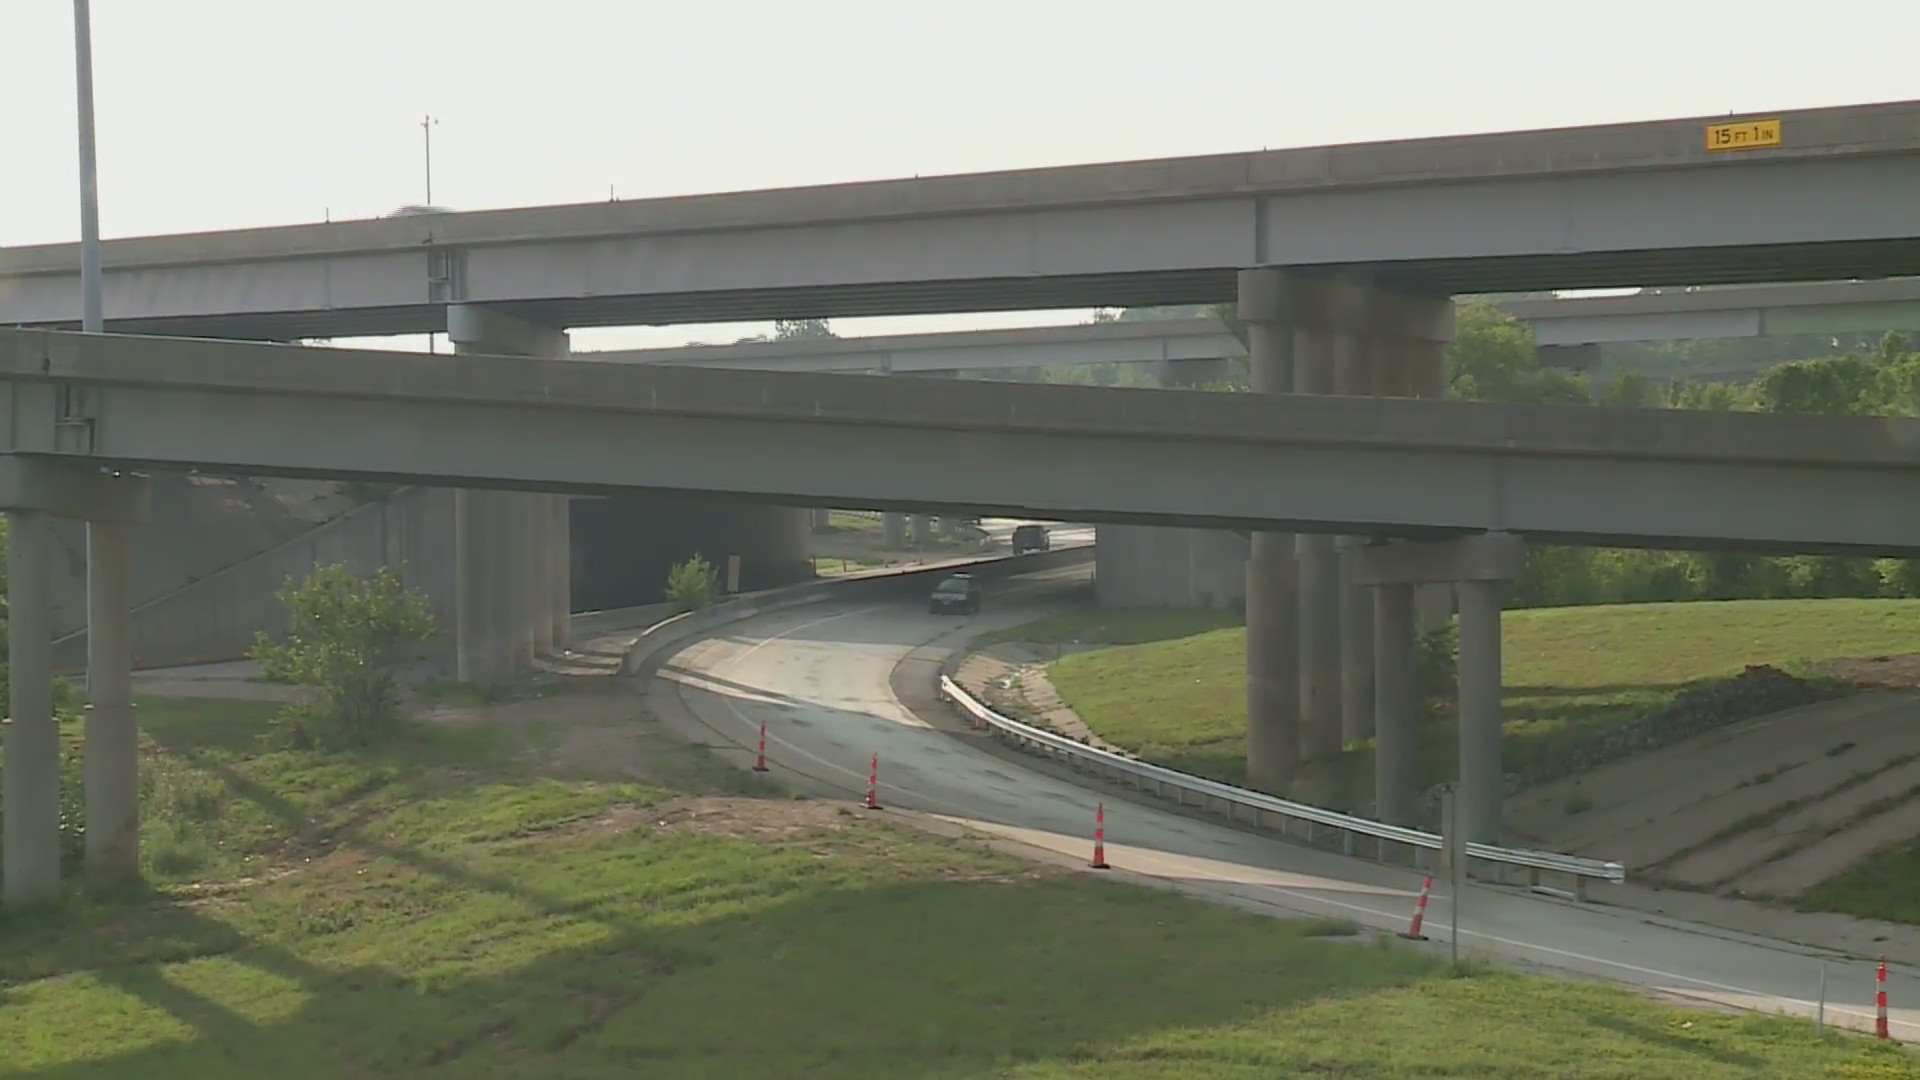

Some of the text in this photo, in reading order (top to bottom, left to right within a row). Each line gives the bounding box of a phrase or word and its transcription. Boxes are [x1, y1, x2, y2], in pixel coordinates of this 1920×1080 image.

[1715, 126, 1774, 145] 15 FT 1 IN
